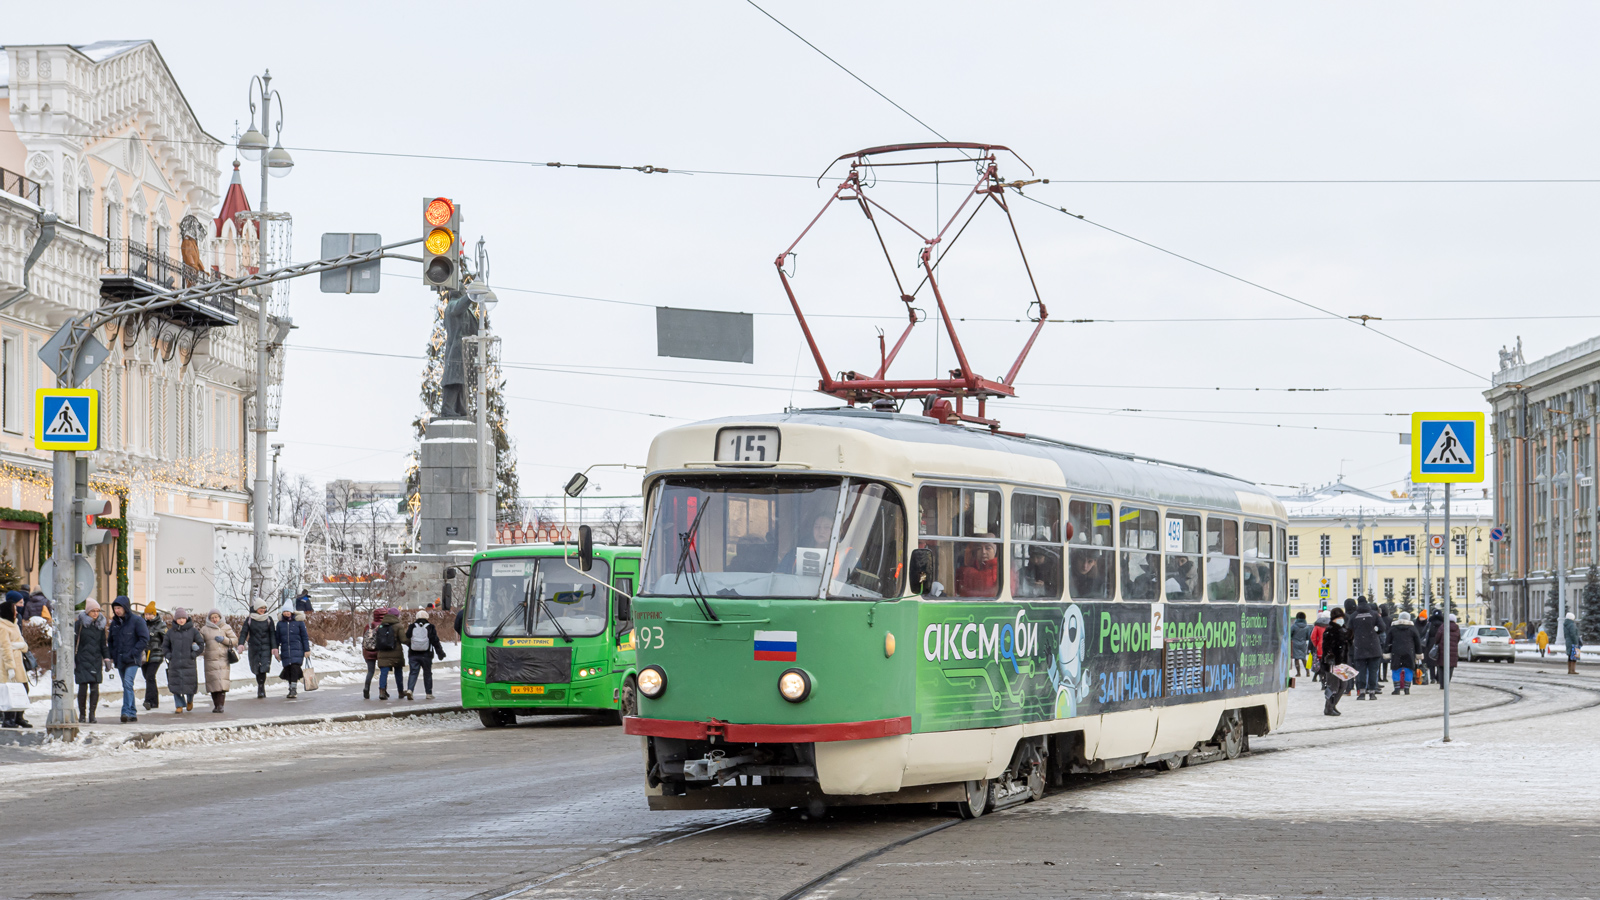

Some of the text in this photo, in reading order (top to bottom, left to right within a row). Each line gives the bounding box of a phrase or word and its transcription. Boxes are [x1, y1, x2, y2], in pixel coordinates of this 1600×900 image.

[730, 434, 766, 462] 15
[1168, 521, 1181, 541] 493
[166, 567, 196, 575] ROLEX
[1099, 611, 1152, 654] Ремон
[1154, 611, 1162, 632] 2
[1099, 669, 1162, 704] ЗАПЧАСТИ
